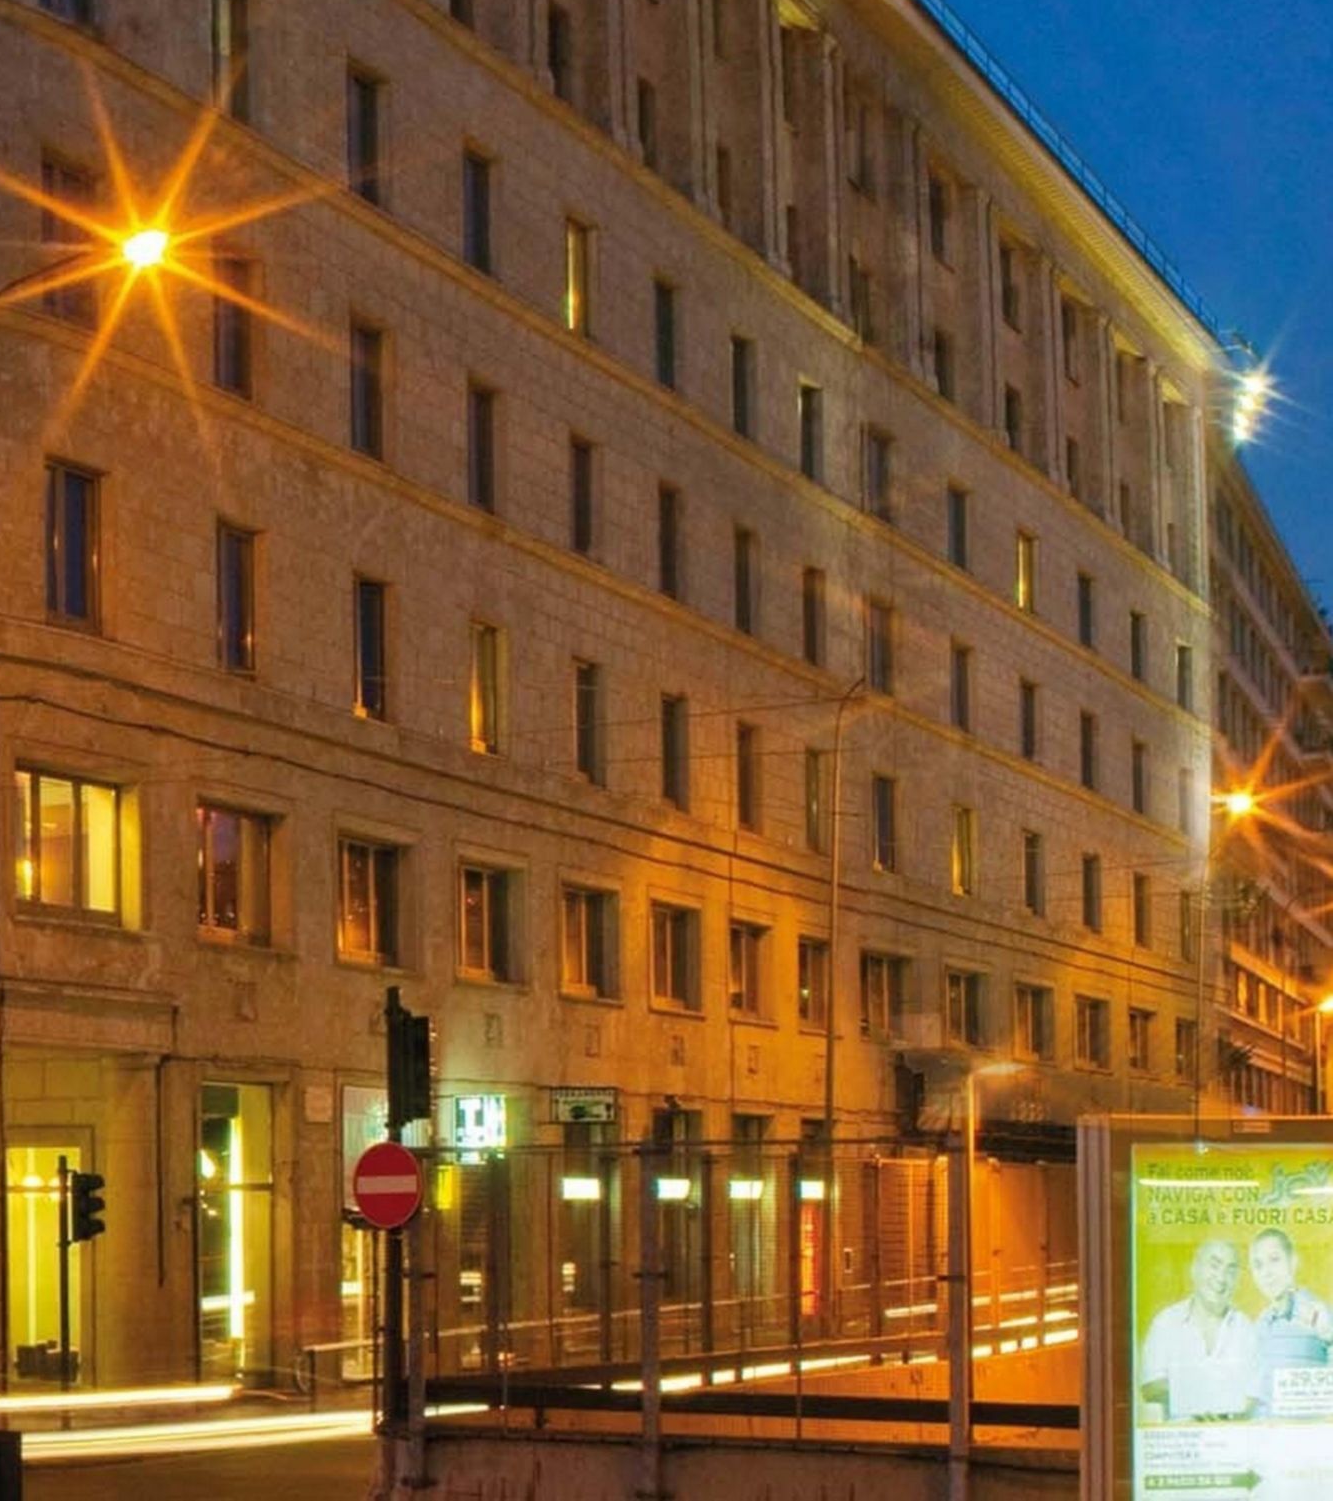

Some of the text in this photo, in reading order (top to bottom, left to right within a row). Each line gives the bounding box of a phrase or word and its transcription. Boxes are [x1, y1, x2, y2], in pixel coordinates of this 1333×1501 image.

[1147, 1186, 1261, 1203] NAVIGA CON
[1161, 1208, 1211, 1225] CASA
[1233, 1208, 1287, 1225] FUORI
